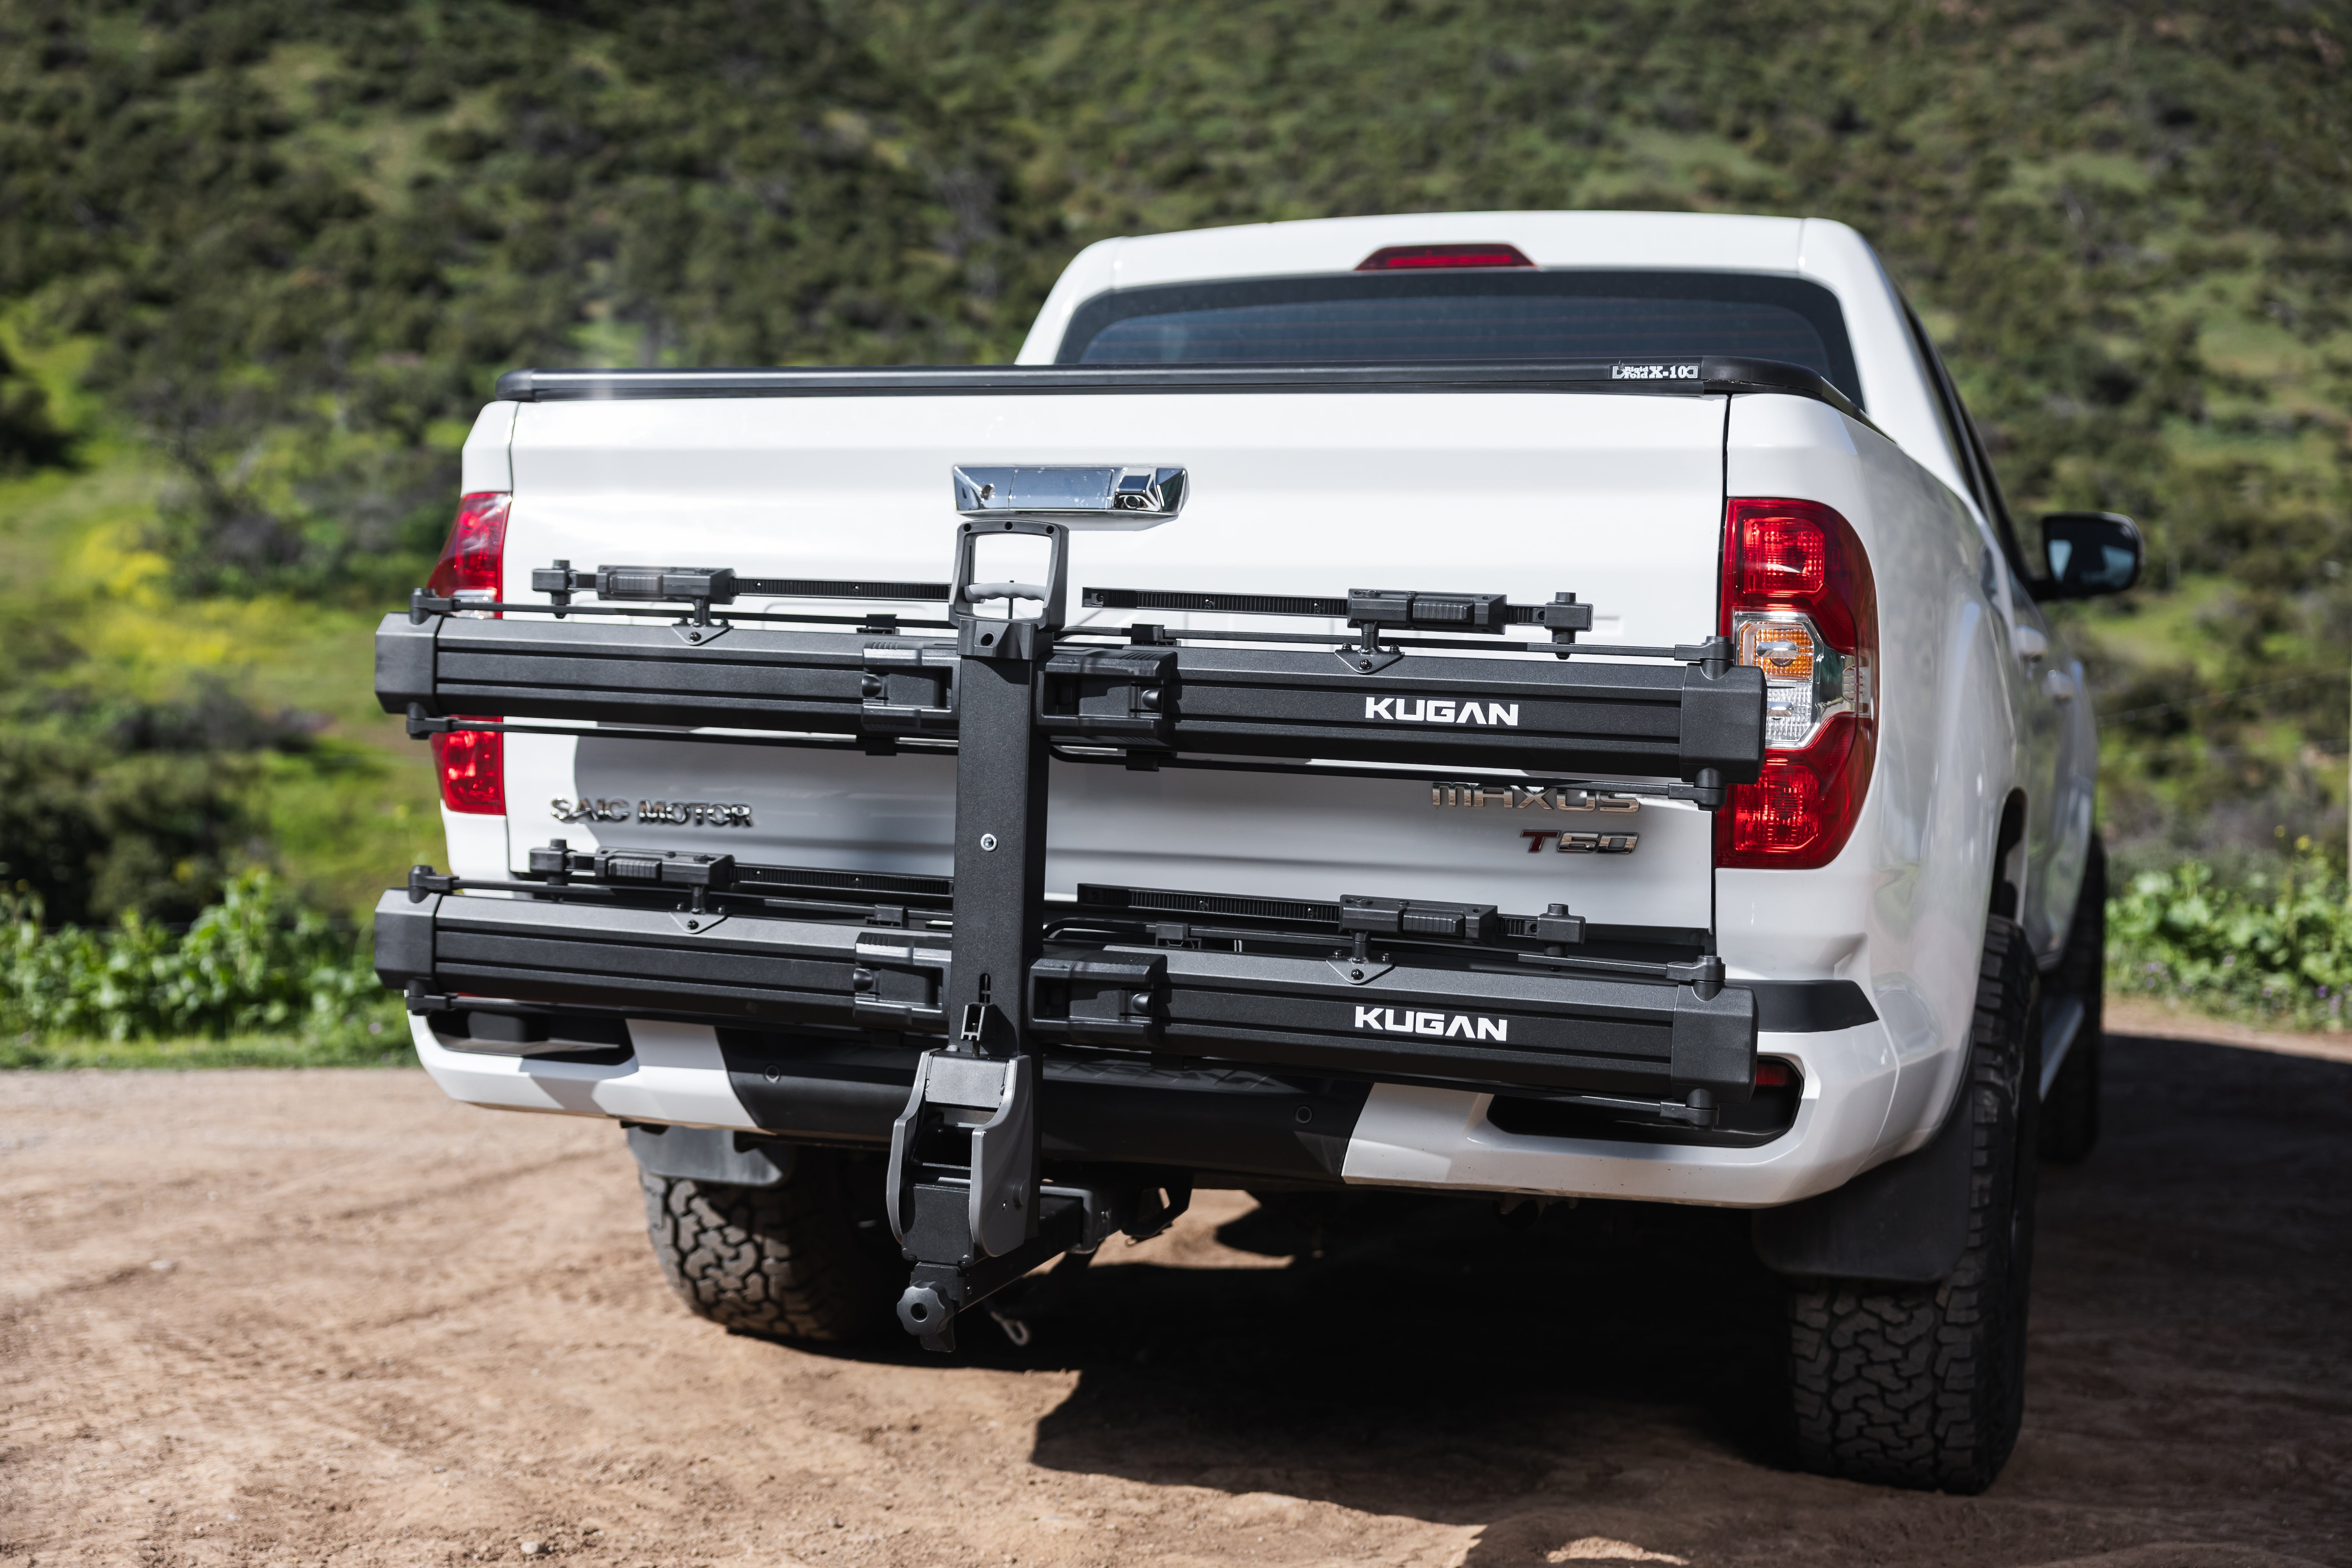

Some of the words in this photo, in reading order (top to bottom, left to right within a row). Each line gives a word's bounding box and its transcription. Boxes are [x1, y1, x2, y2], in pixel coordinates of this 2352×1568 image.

[1649, 365, 1687, 379] X-10
[1365, 697, 1519, 726] KUGAN
[551, 796, 630, 823] SAIC
[638, 799, 754, 827] MOTOR
[1432, 782, 1640, 813] MAXUS
[1520, 829, 1639, 854] T60
[1355, 1006, 1508, 1041] KUGAN
